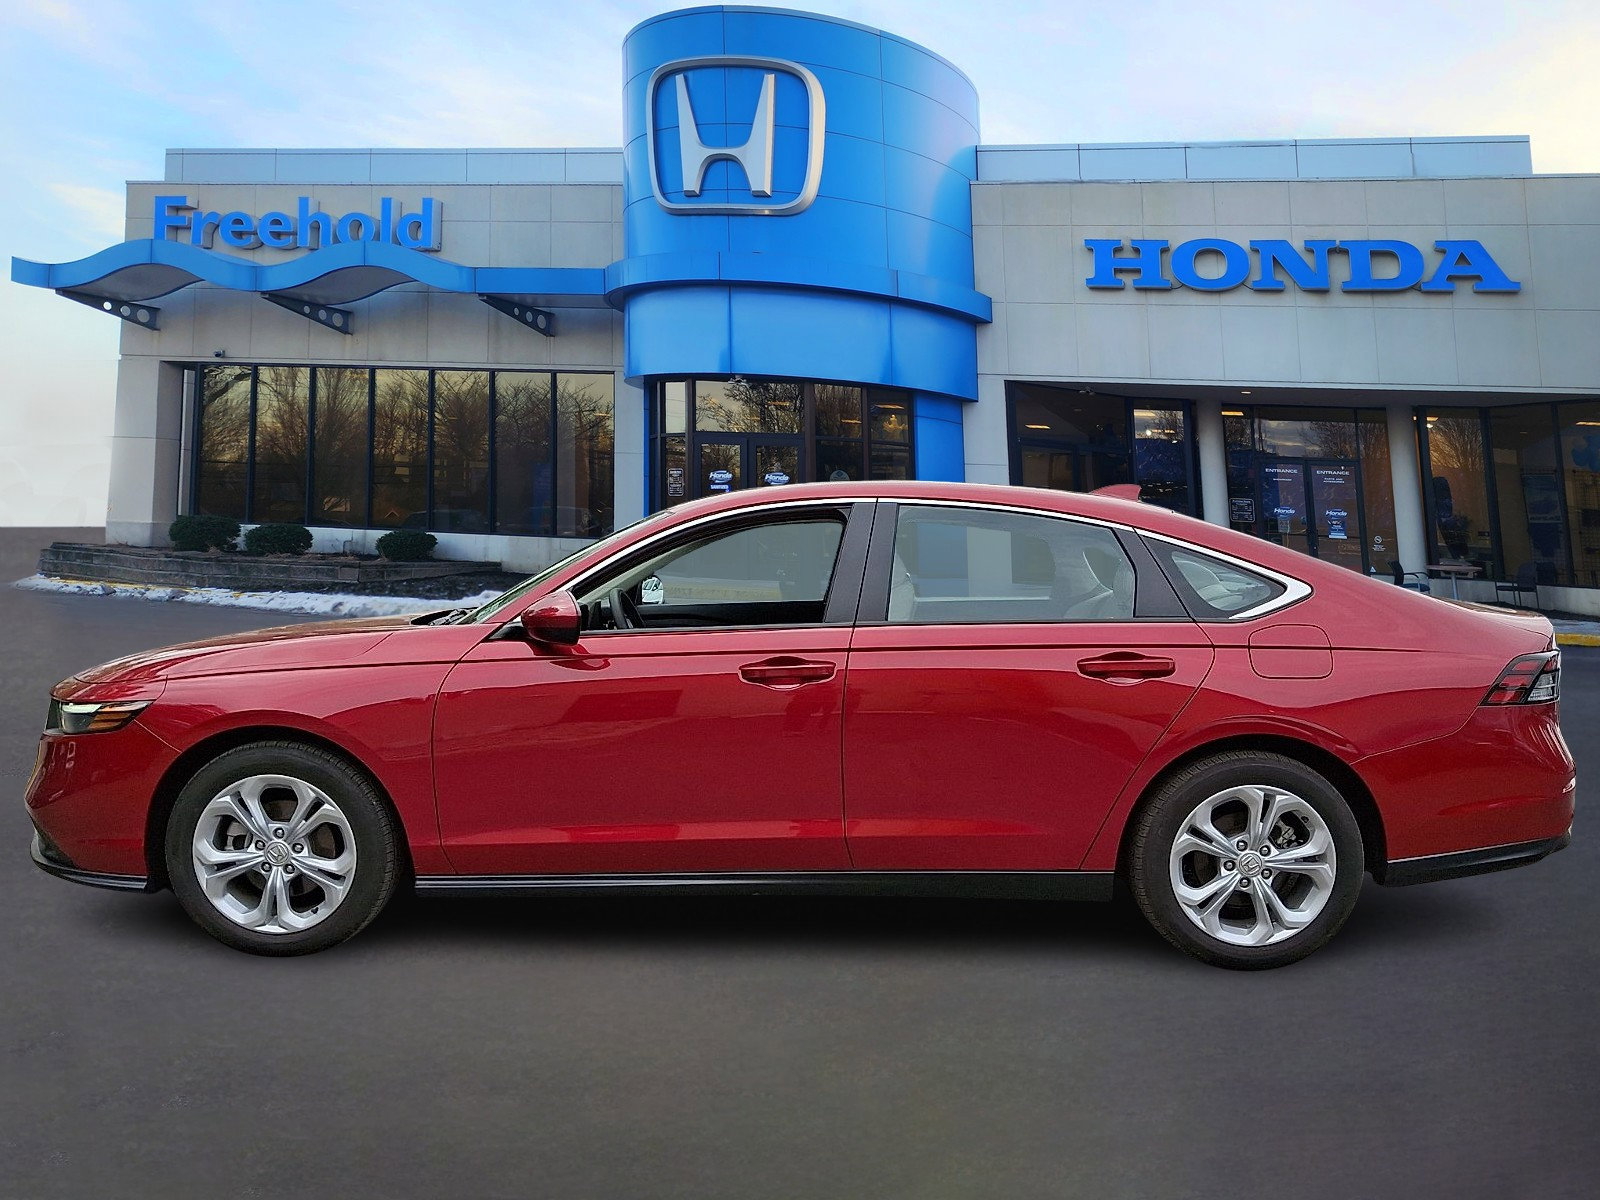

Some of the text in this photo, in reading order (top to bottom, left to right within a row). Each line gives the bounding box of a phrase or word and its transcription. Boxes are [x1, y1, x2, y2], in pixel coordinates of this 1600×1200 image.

[153, 195, 442, 251] Freehold
[1084, 238, 1522, 292] HONDA
[765, 474, 789, 482] Honda
